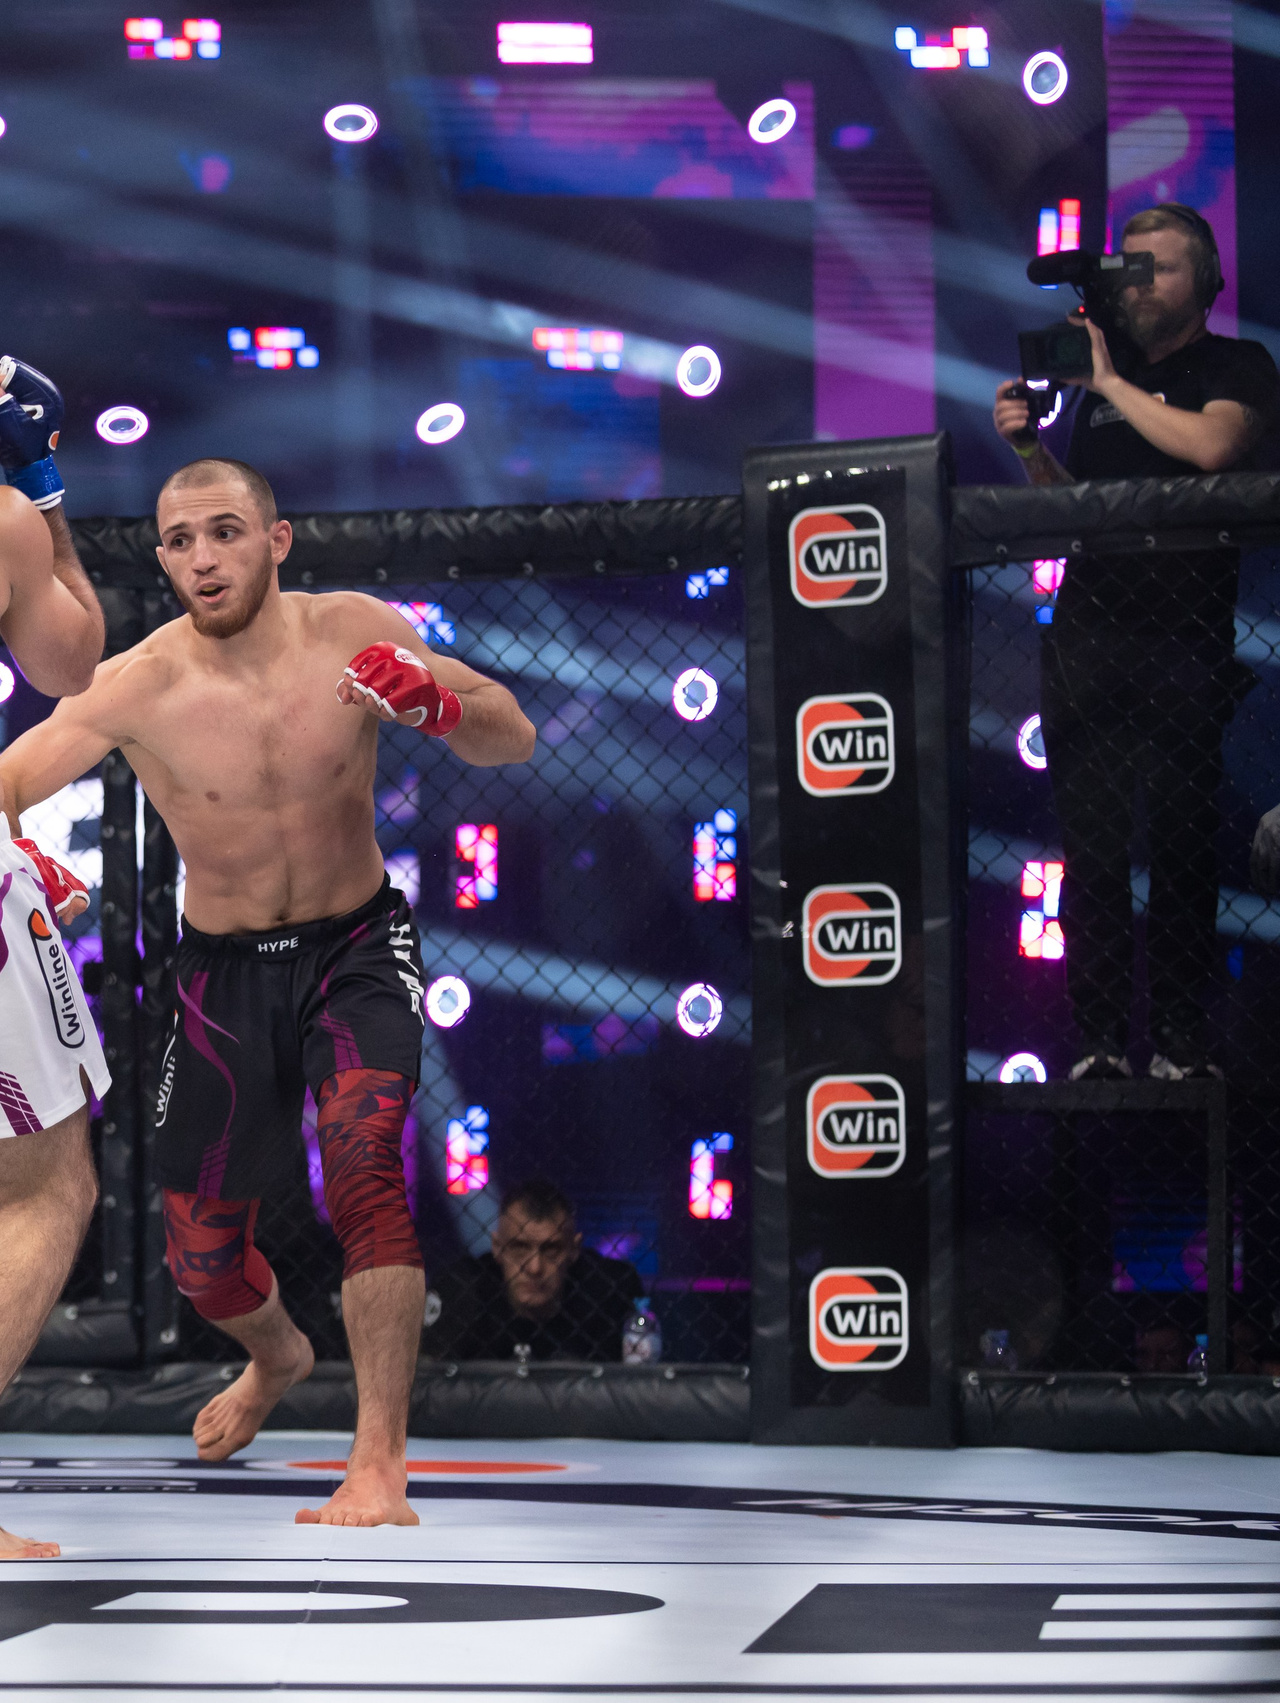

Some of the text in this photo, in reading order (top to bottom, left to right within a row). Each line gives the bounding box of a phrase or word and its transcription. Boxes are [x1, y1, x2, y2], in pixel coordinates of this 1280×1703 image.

[811, 541, 878, 572] Win
[820, 730, 887, 761] Win
[257, 936, 299, 952] HYPE
[825, 921, 893, 951] Win
[49, 943, 81, 1037] Winline
[156, 1056, 176, 1112] Winl
[829, 1112, 898, 1142] Win
[832, 1304, 900, 1335] Win
